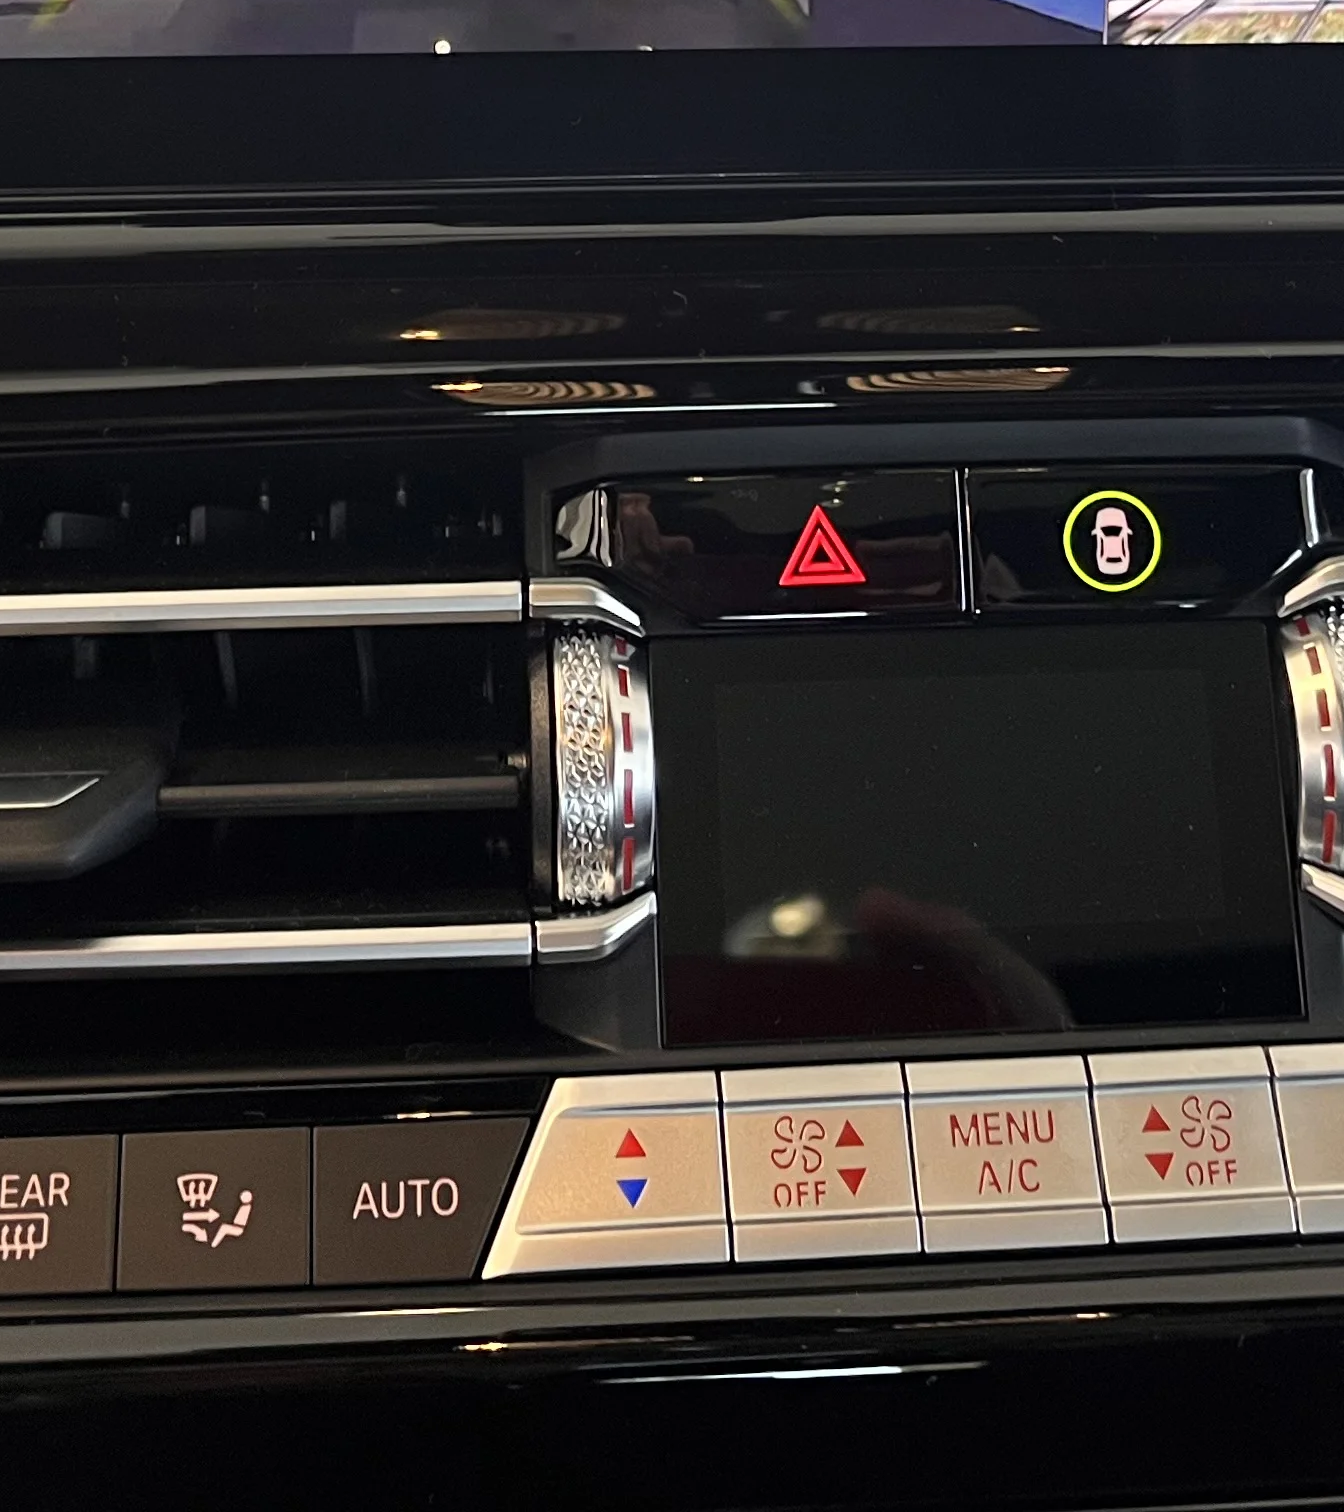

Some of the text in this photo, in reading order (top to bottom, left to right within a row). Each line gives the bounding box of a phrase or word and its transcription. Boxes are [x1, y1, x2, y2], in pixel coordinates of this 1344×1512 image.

[949, 1109, 1055, 1148] MENU
[977, 1159, 1041, 1196] A/C
[1184, 1158, 1239, 1188] OFF
[352, 1178, 460, 1220] AUTO
[773, 1180, 828, 1209] OFF
